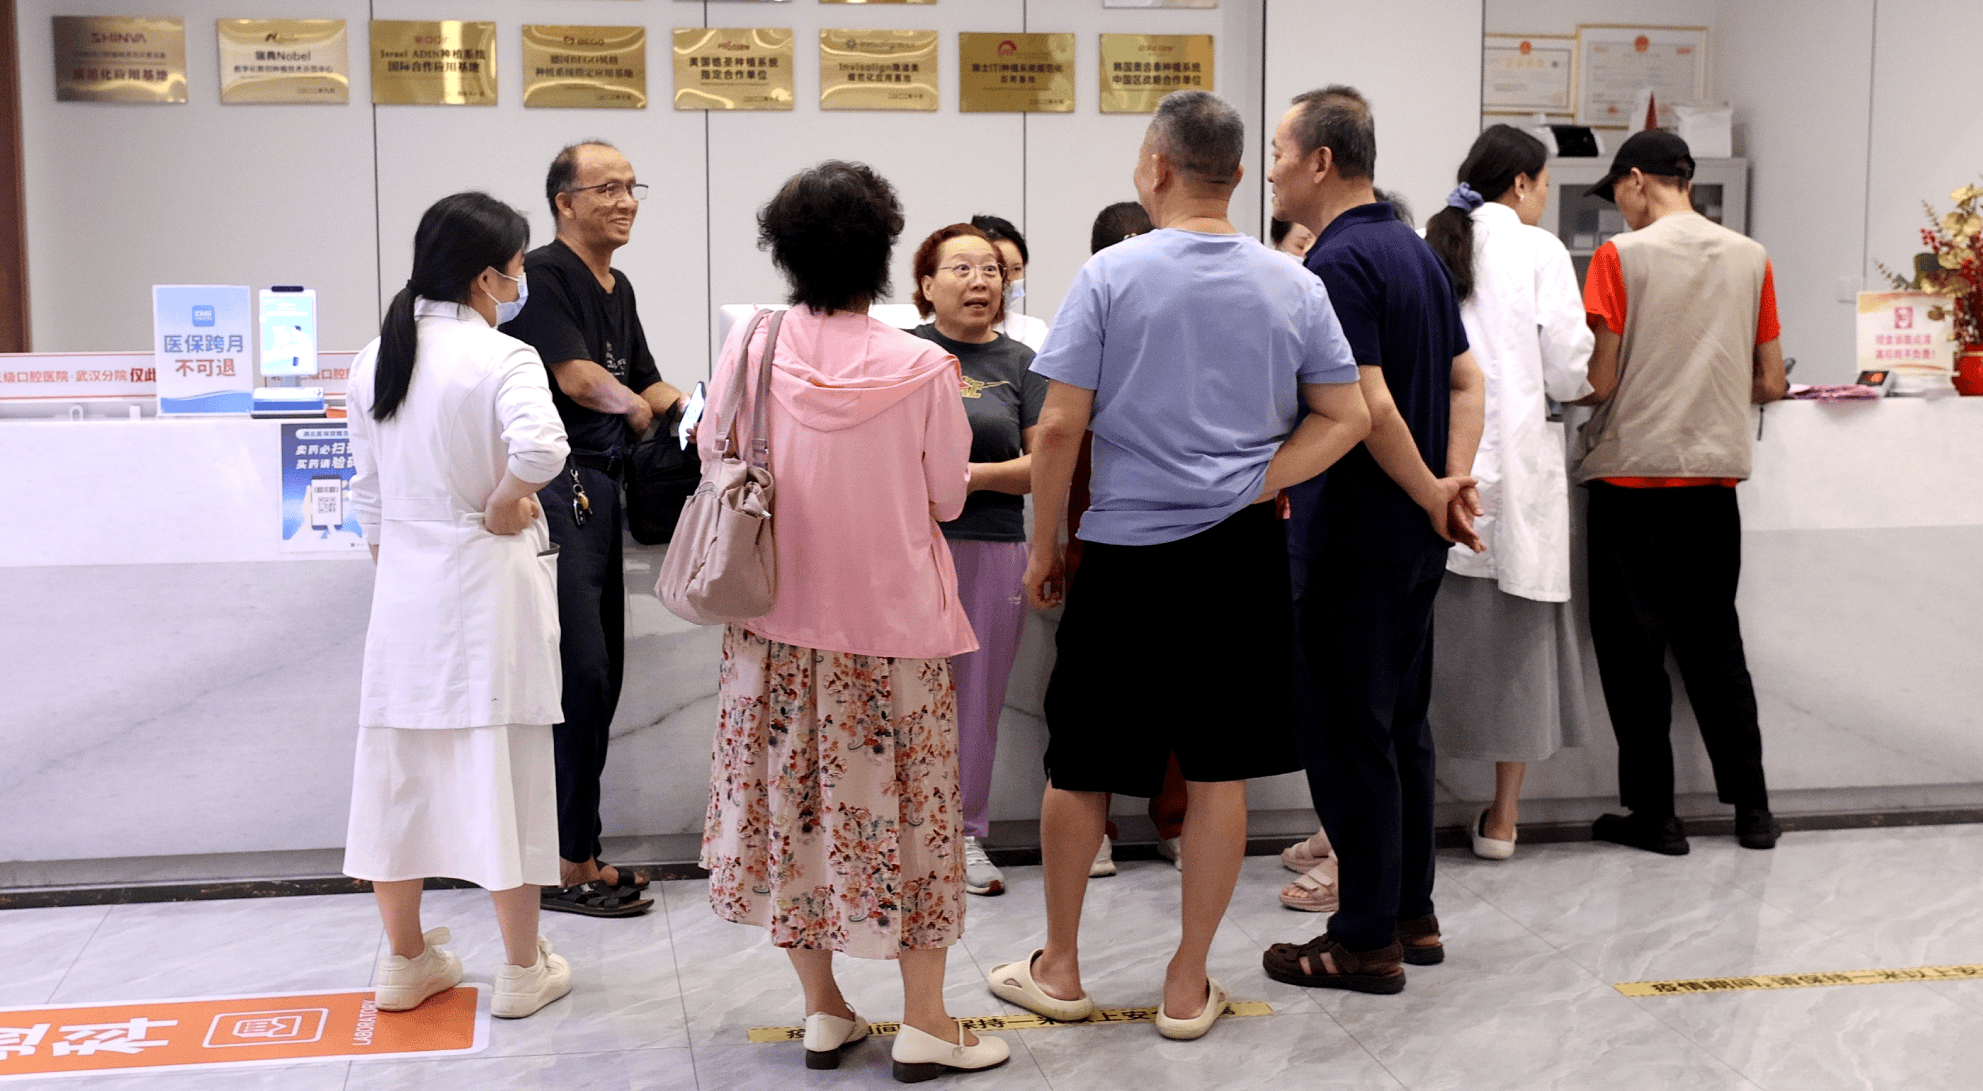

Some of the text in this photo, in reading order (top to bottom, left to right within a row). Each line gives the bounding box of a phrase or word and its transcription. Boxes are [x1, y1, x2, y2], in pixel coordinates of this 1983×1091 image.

[255, 50, 312, 61] 瑞典Nobel
[387, 60, 480, 73] 国际合作应用基地
[701, 69, 768, 80] 指定合作单位
[163, 333, 244, 355] 医保跨月
[175, 358, 236, 378] 不可退
[352, 999, 379, 1046] LABORATORY
